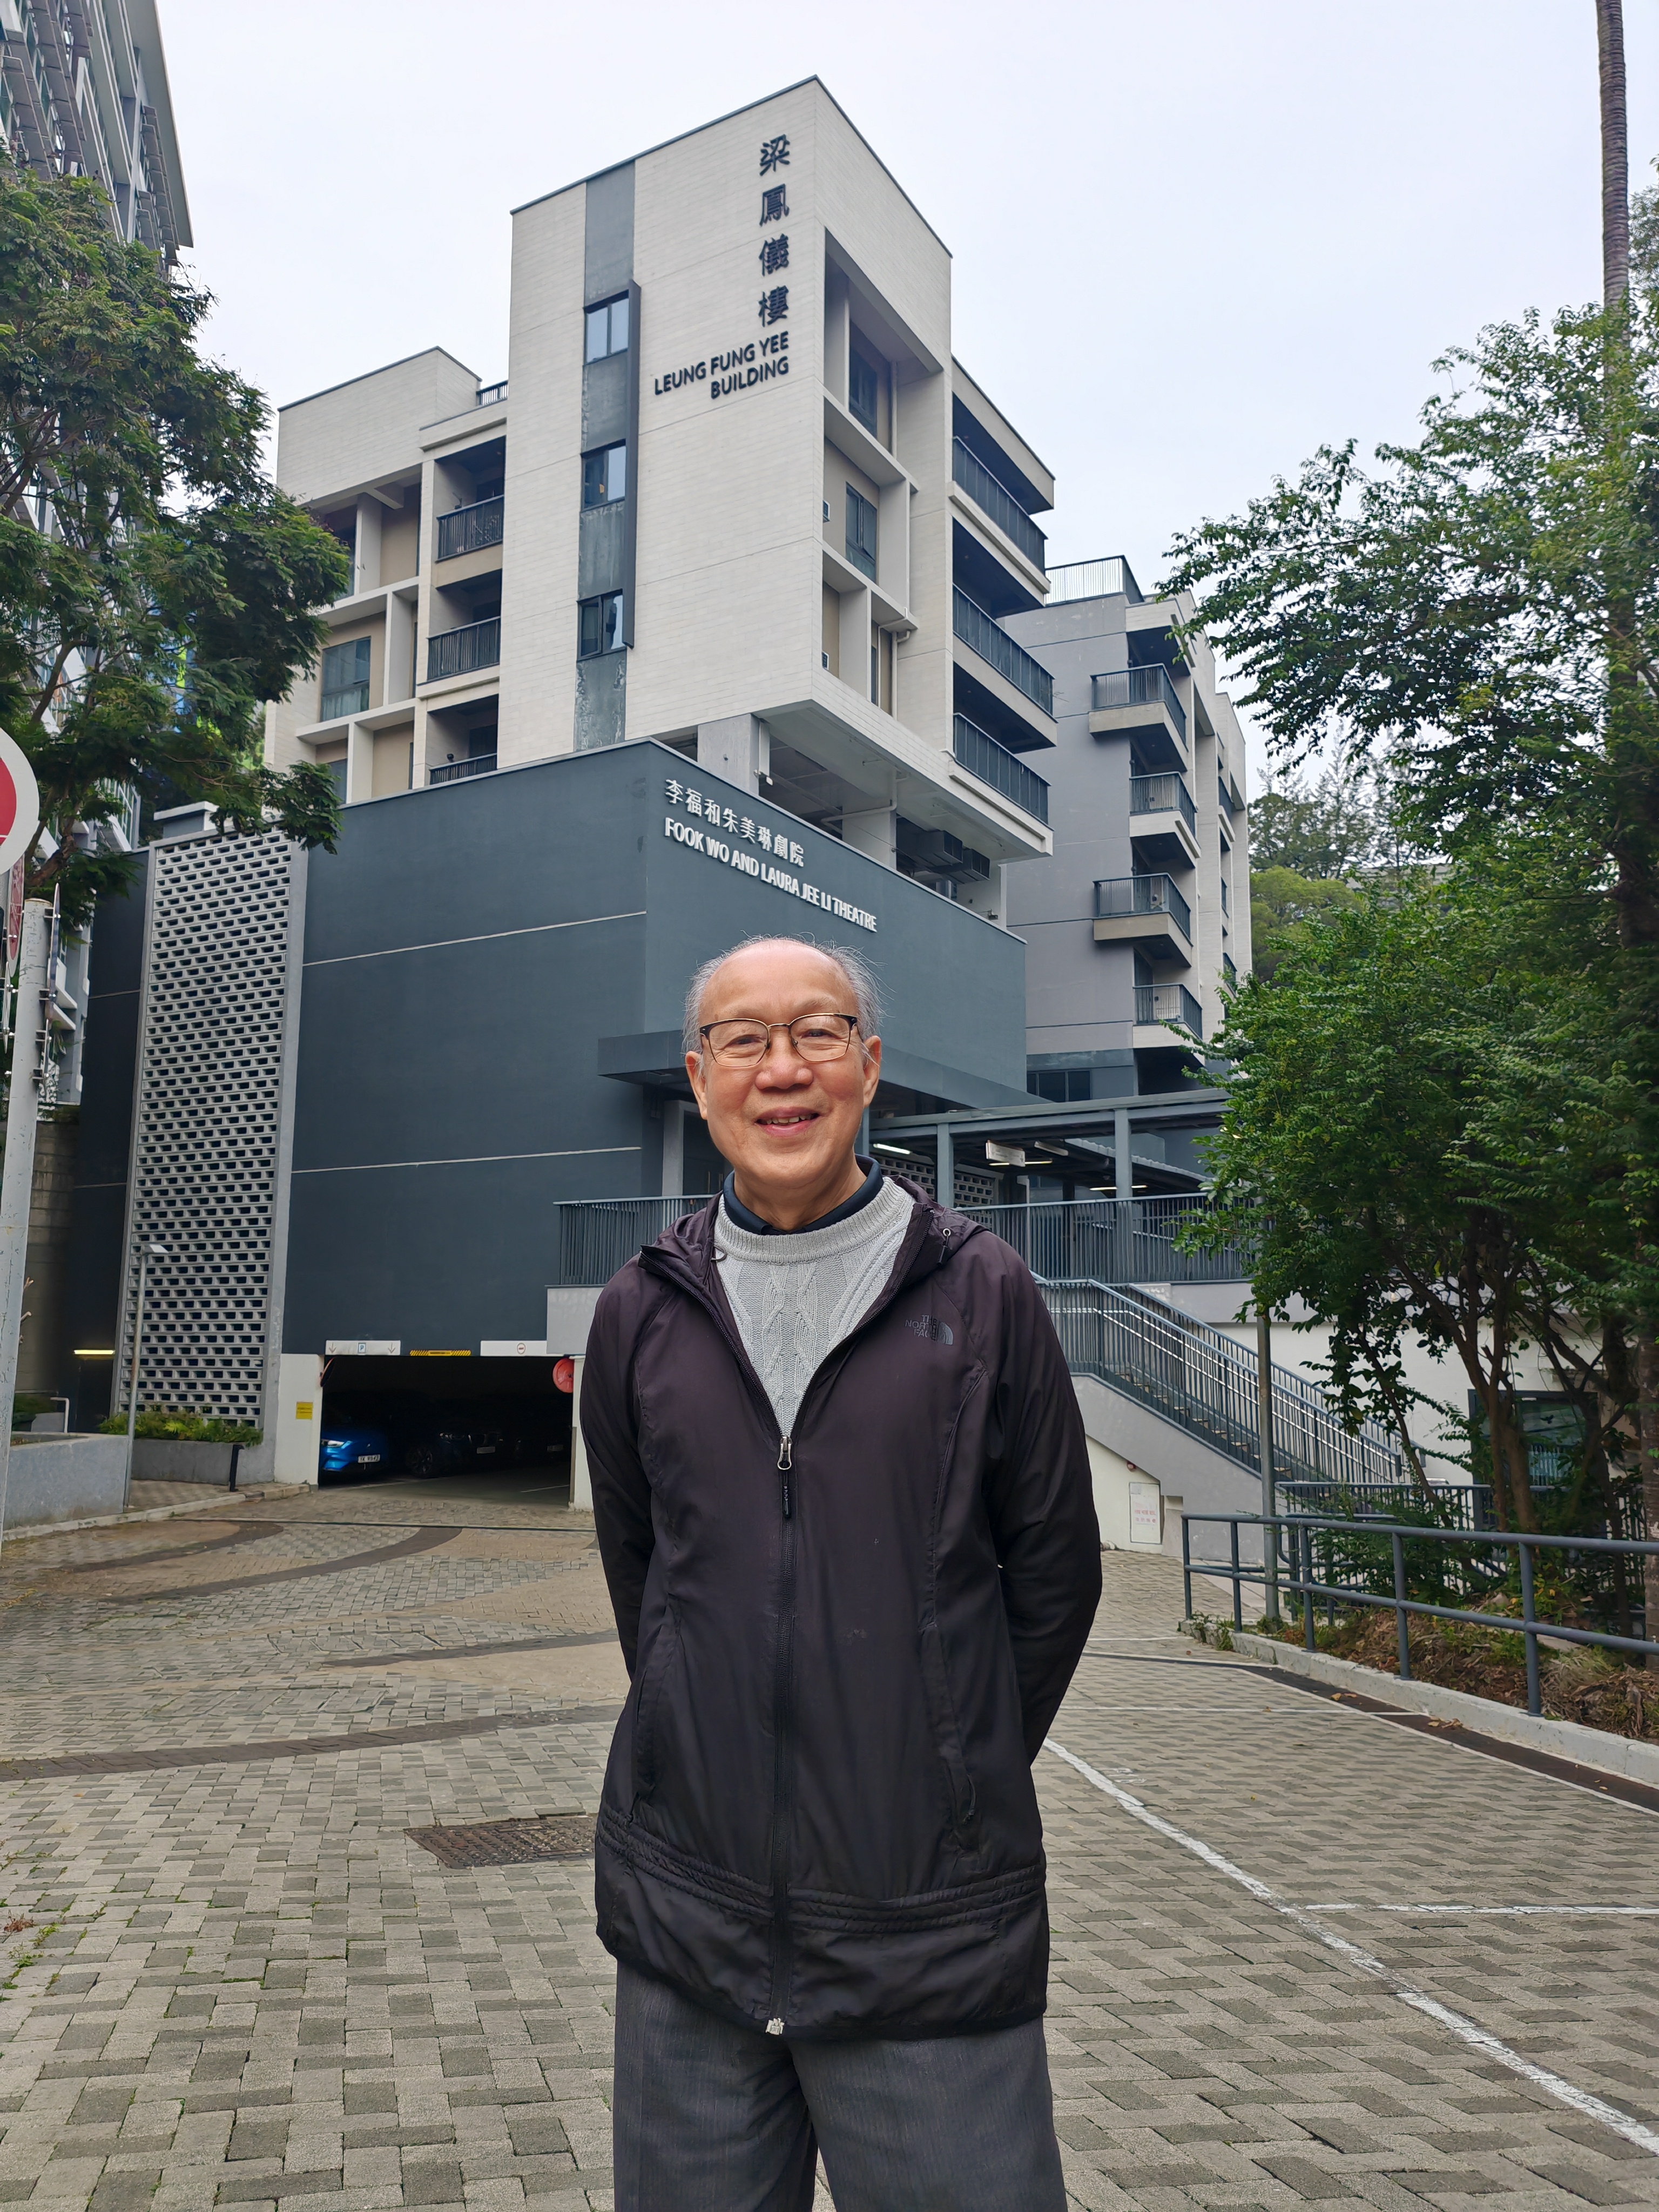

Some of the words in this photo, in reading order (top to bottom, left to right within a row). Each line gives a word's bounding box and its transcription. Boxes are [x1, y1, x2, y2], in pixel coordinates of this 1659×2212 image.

[759, 133, 790, 328] 梁鳳儀樓
[655, 361, 707, 396] LEUNG
[710, 343, 756, 376] FUNG
[759, 331, 790, 357] YEE
[710, 355, 790, 400] BUILDING
[665, 779, 804, 867] 李福和朱美琳劇院
[665, 817, 704, 852] FOOK
[706, 837, 730, 863] WO
[731, 850, 759, 877] AND
[760, 863, 800, 897] LAURA
[800, 883, 820, 906] JEE
[820, 892, 832, 912] LI
[832, 897, 878, 933] THEATRE
